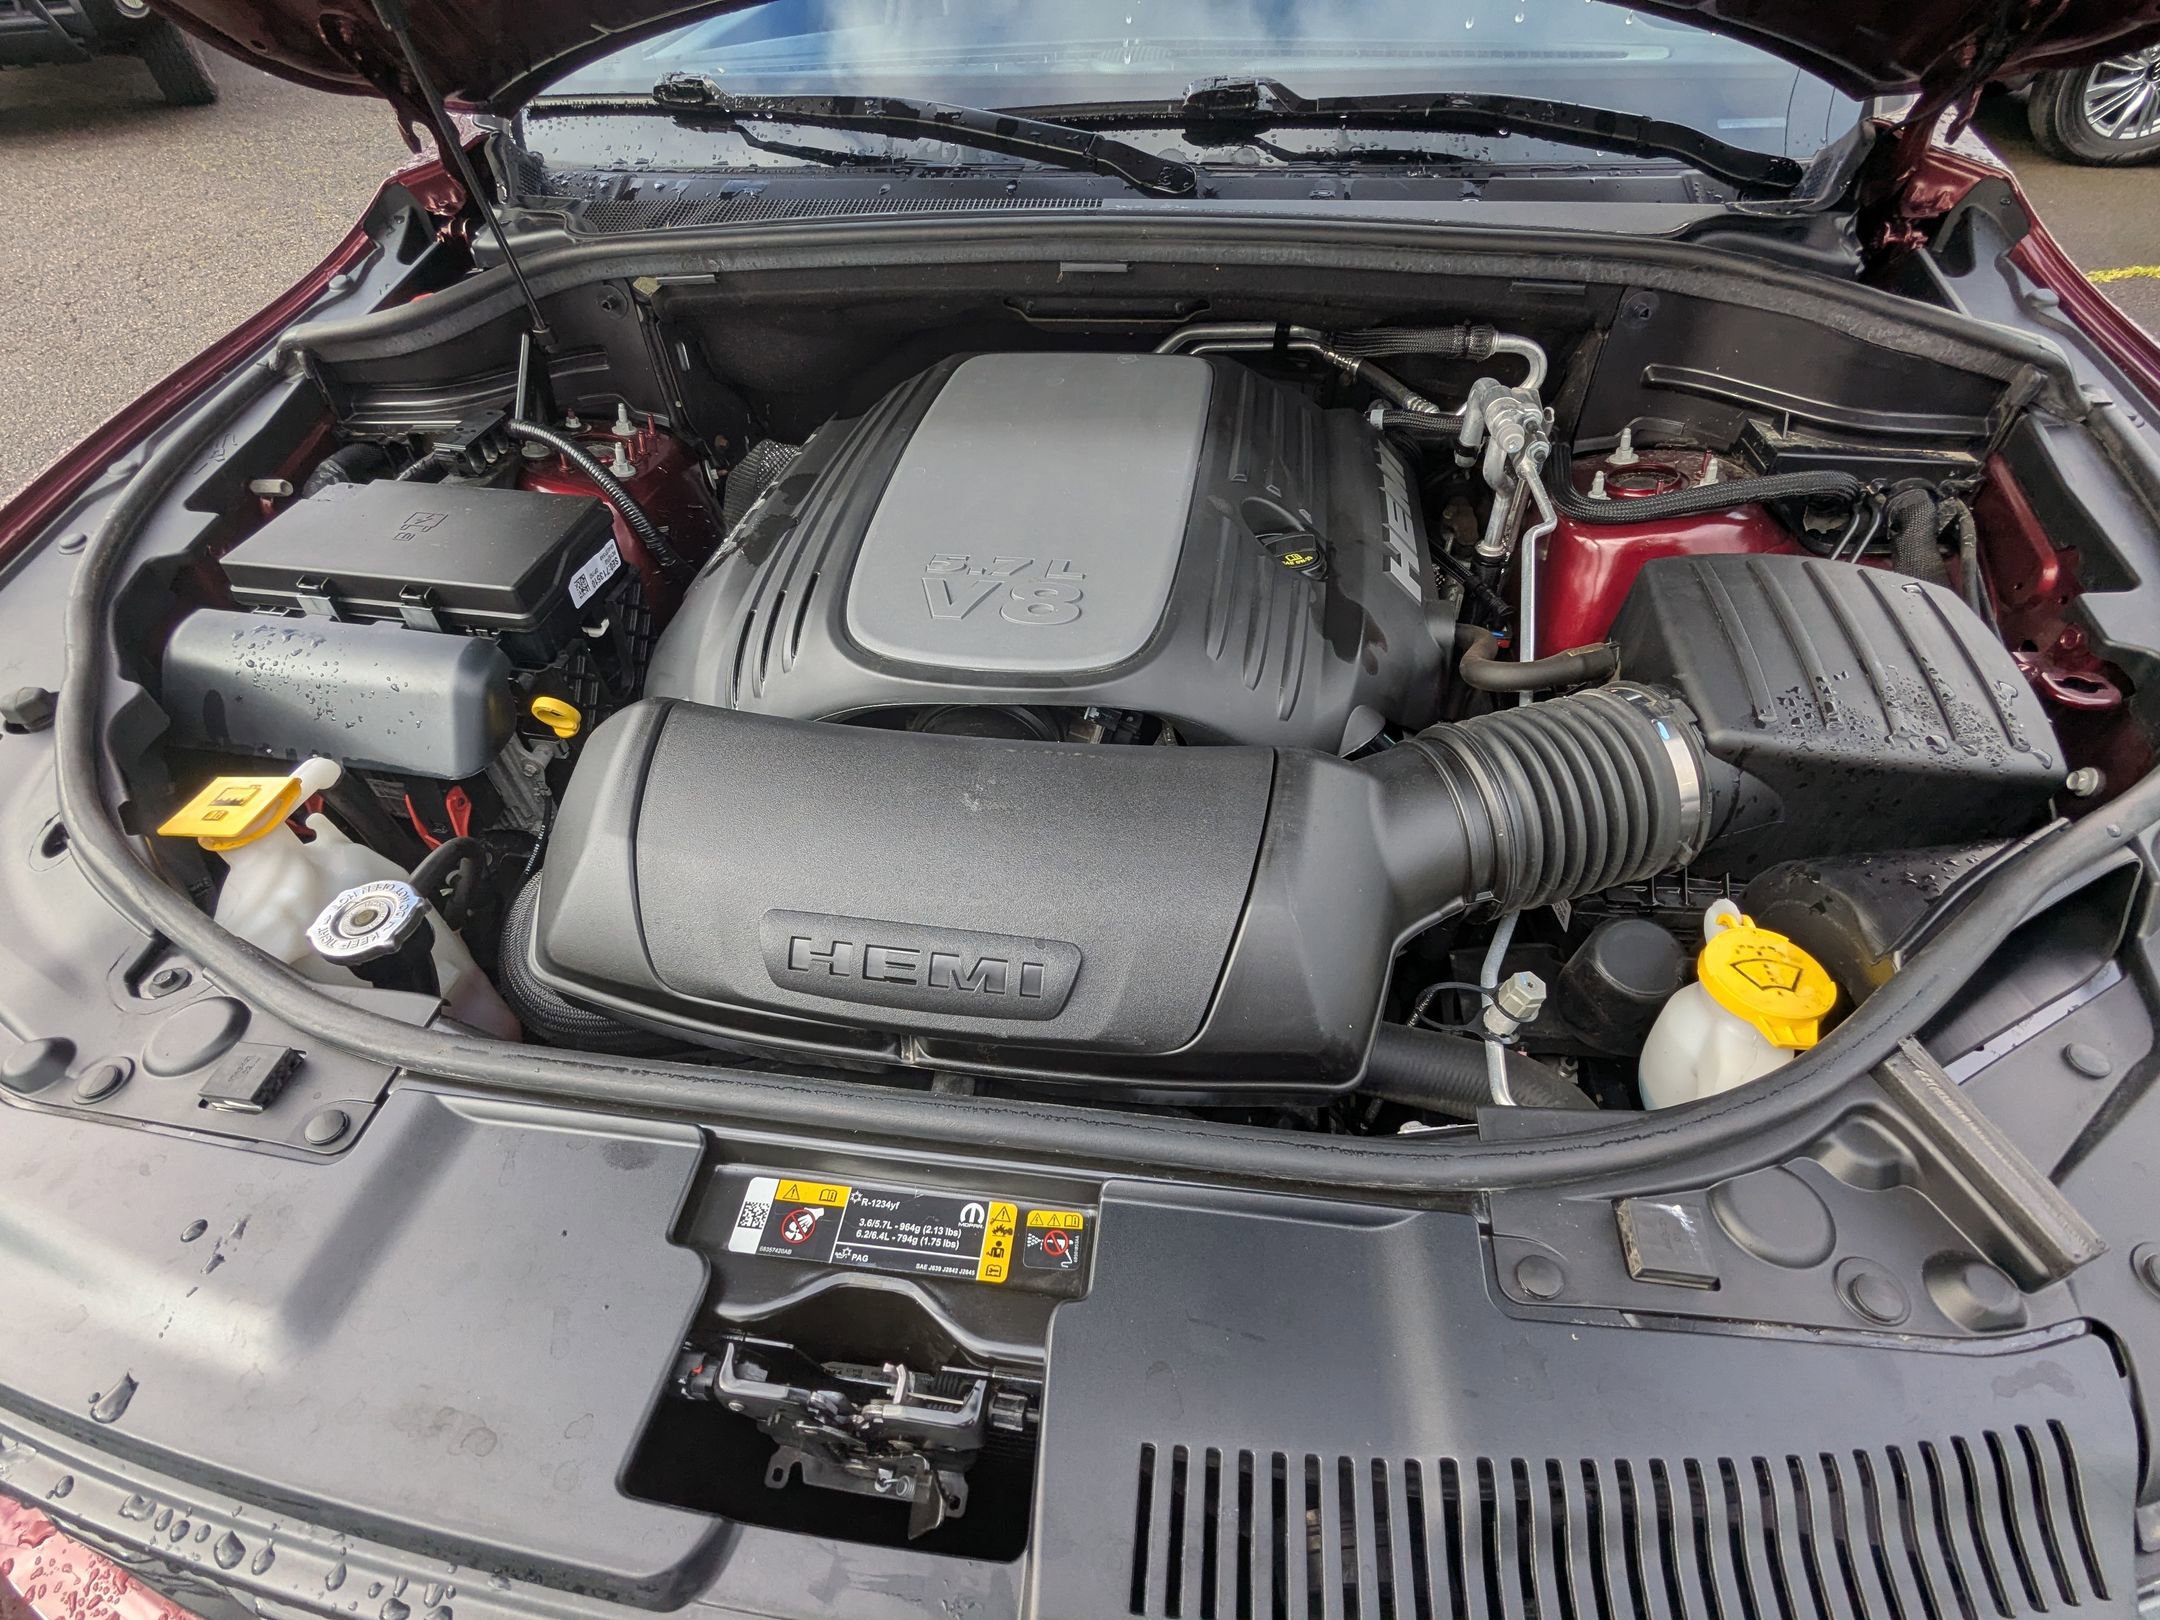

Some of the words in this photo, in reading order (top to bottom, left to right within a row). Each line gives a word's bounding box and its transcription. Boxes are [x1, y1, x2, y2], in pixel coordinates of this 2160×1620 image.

[925, 553, 1087, 581] 5.7L
[921, 577, 1085, 626] V8
[787, 935, 1045, 999] HEMI
[860, 1197, 901, 1211] R-1234yf
[858, 1218, 893, 1230] 3.6/5.7L
[899, 1222, 921, 1234] 964g
[922, 1224, 944, 1236] (2.13
[944, 1226, 962, 1238] lbs)
[856, 1229, 890, 1241] 6.2/6.4L
[896, 1233, 918, 1246] 794g
[919, 1235, 941, 1248] (1.75
[942, 1238, 960, 1250] lbs)
[851, 1253, 869, 1262] PAG
